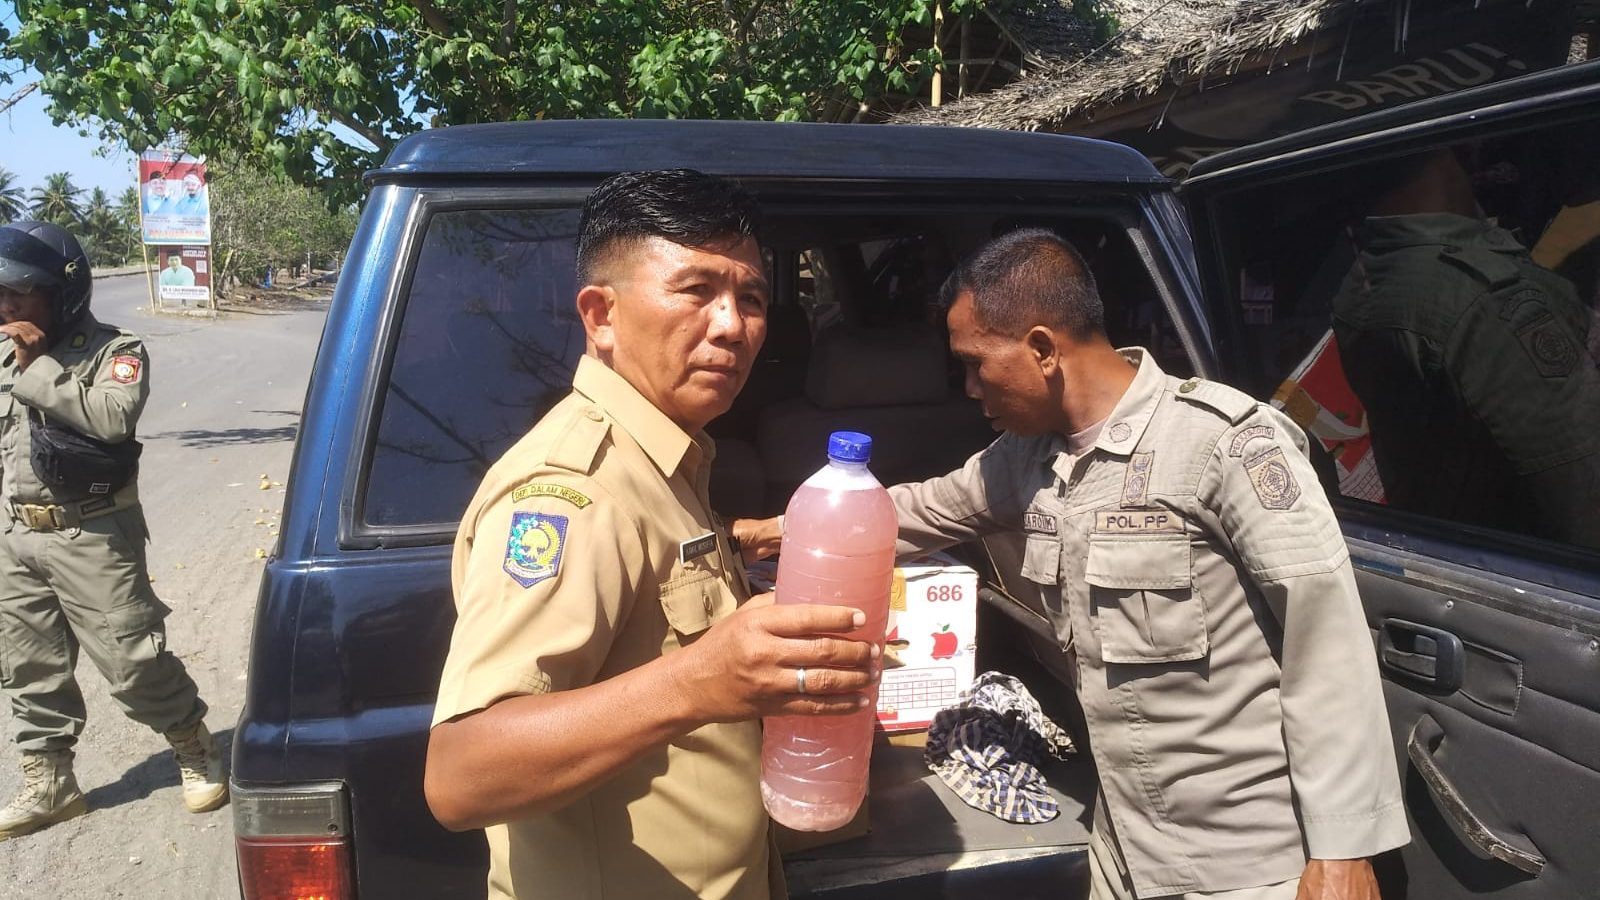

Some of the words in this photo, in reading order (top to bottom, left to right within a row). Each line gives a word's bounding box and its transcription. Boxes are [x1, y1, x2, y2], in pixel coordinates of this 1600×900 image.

[1299, 42, 1527, 110] BARU!
[530, 485, 558, 494] DALAM
[560, 488, 586, 505] NEGERI
[926, 584, 963, 603] 686
